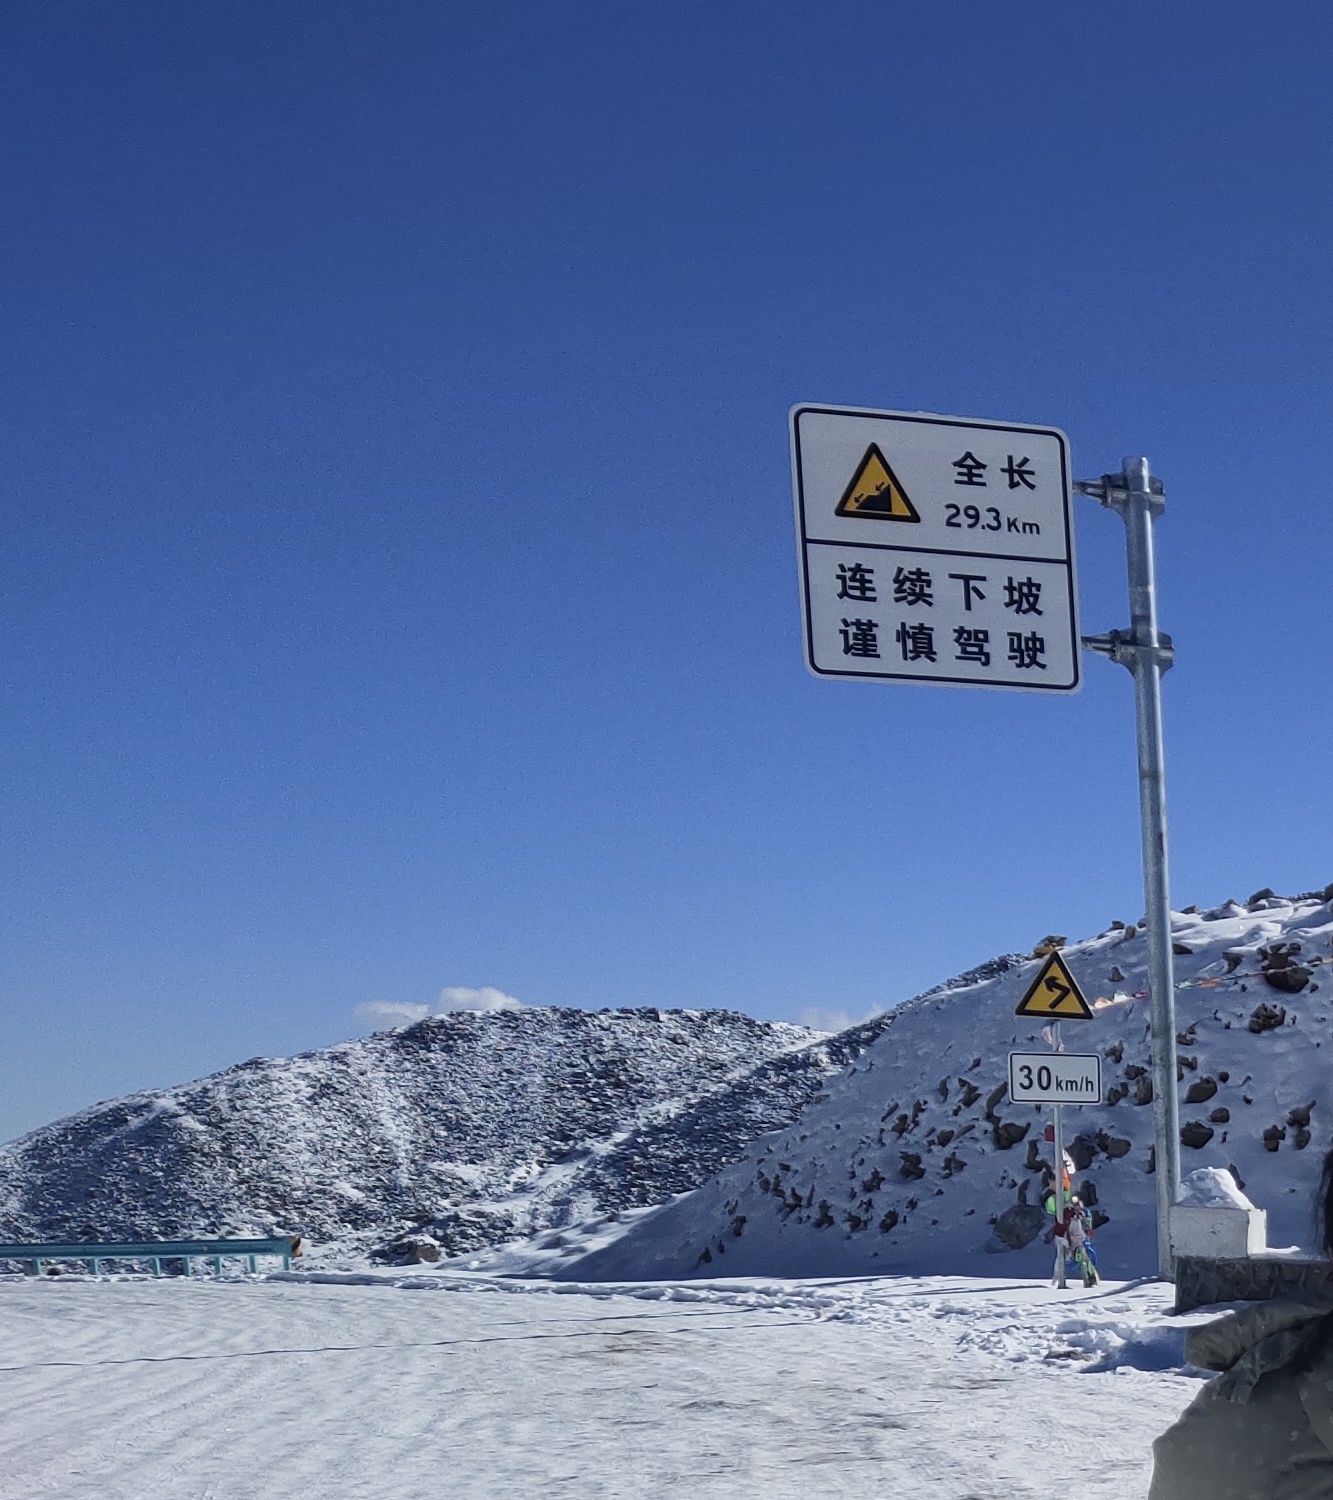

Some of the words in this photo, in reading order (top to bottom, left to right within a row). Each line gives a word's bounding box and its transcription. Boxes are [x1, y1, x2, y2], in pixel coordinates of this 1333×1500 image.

[951, 451, 1037, 491] 全长
[834, 562, 1044, 617] 连续下坡
[838, 618, 1048, 670] 谨慎驾驶
